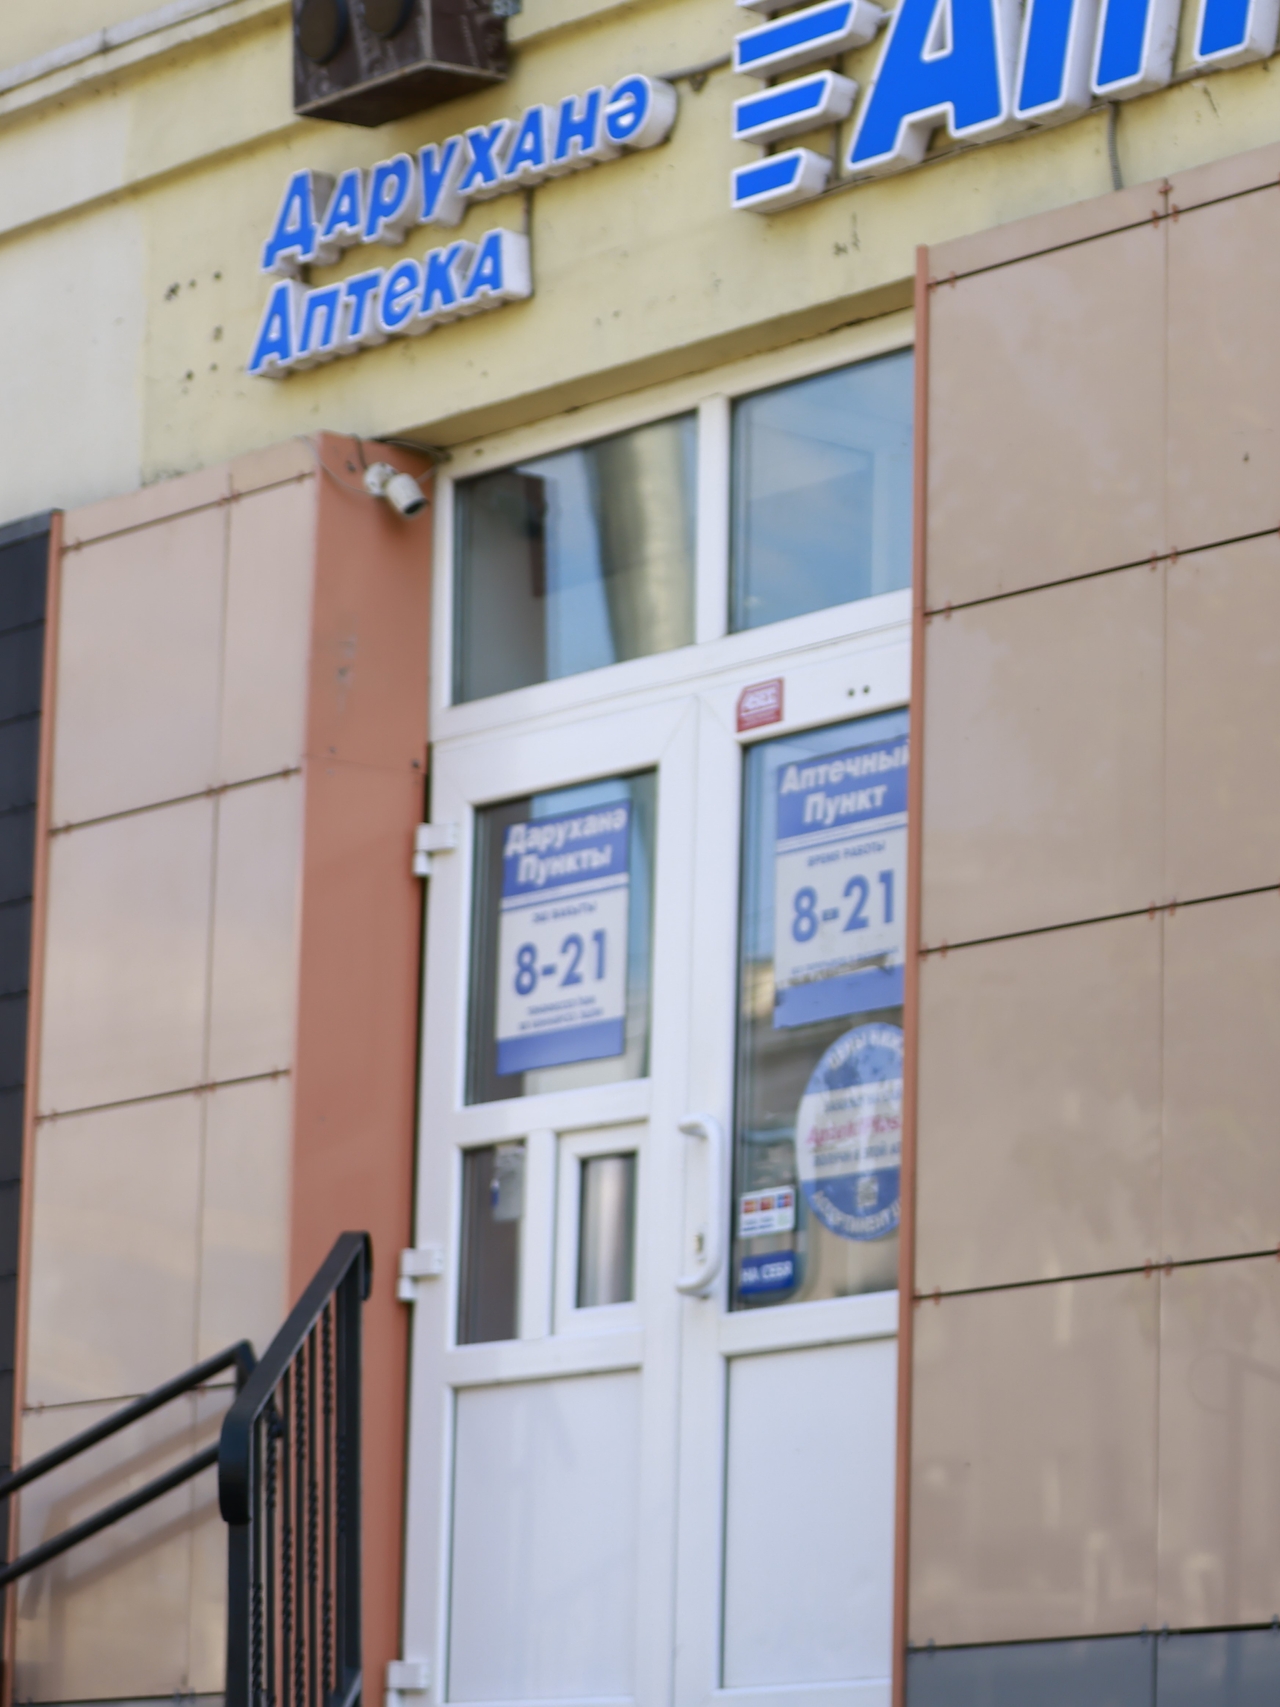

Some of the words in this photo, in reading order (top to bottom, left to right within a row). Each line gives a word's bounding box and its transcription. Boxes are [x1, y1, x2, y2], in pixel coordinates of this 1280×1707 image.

[247, 227, 508, 377] Аптека
[803, 785, 887, 825] Пункт
[517, 844, 613, 888] Пункты
[791, 870, 896, 942] 8-21
[514, 929, 607, 996] 8-21
